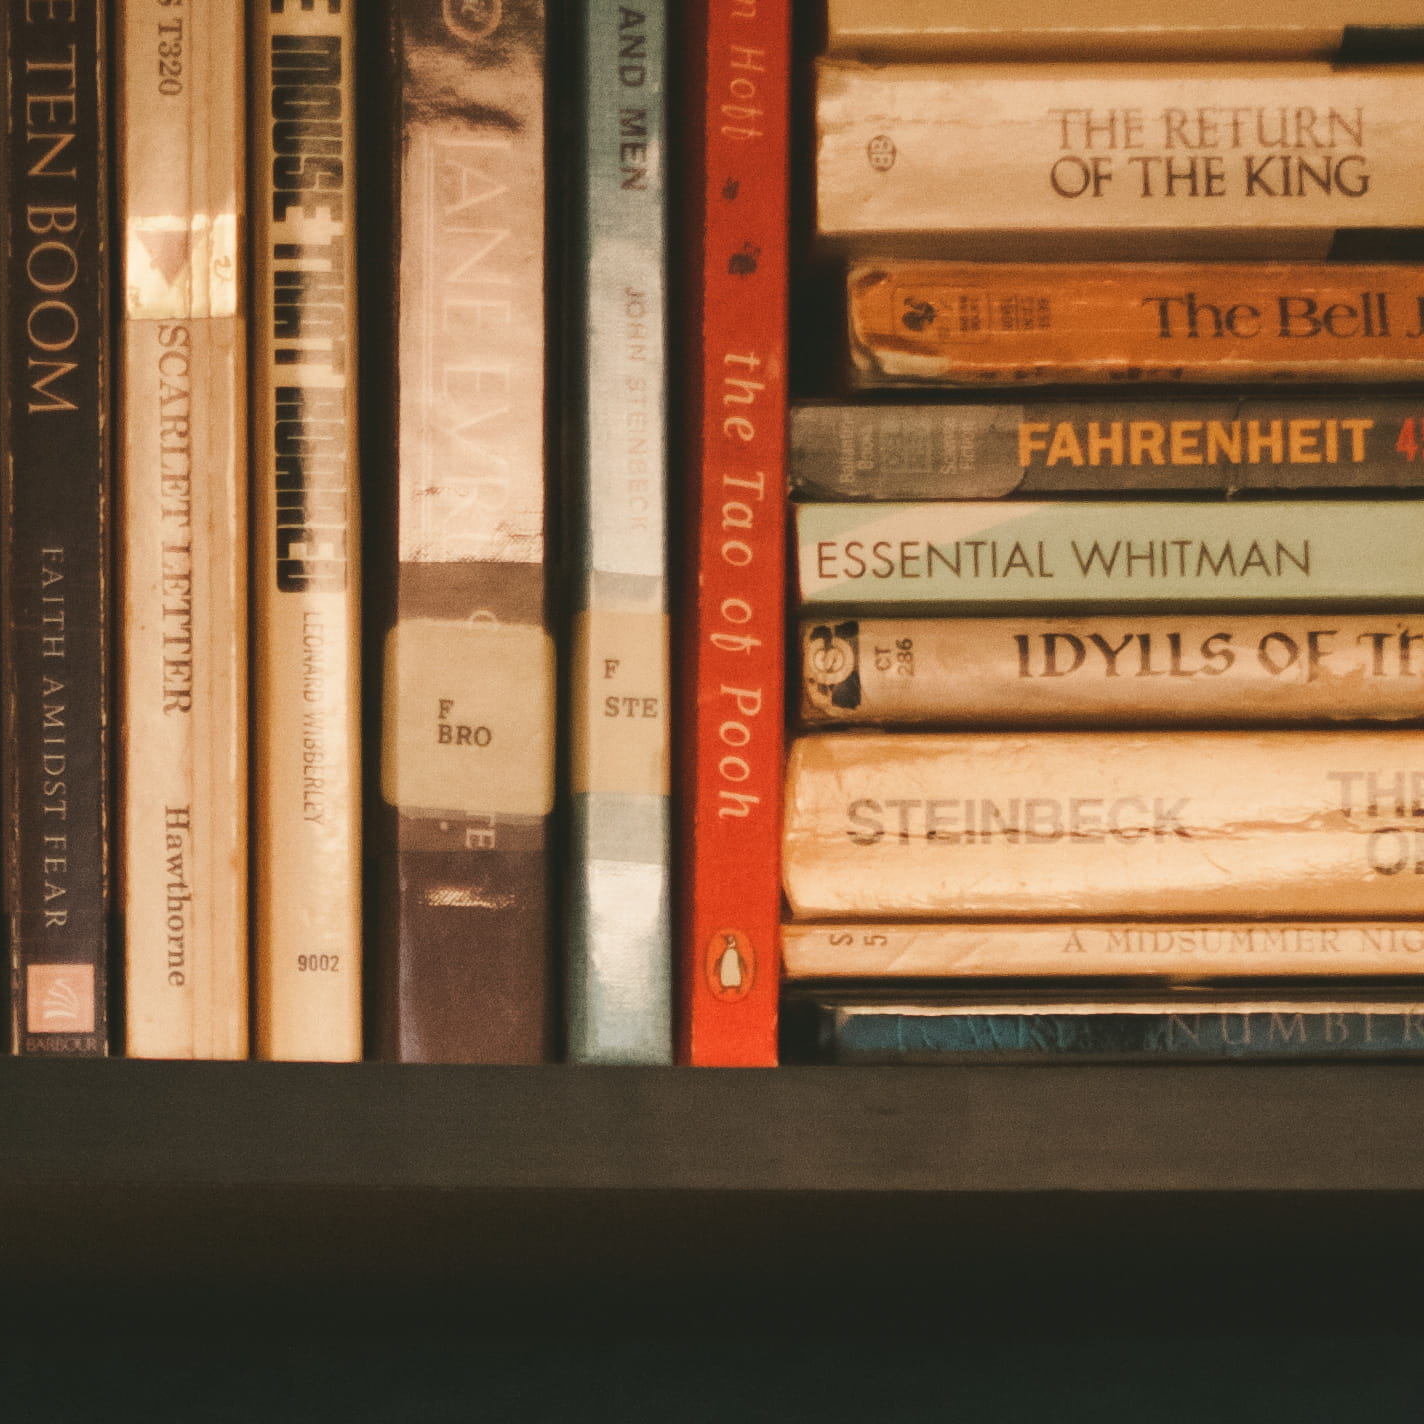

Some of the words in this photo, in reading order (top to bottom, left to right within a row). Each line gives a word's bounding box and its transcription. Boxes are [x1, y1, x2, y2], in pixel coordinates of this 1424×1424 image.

[158, 19, 183, 97] T320
[619, 6, 646, 87] AND
[26, 44, 77, 182] TEN
[1047, 107, 1145, 150] THE
[1162, 106, 1366, 150] RETURN
[620, 107, 648, 192] MEN
[1050, 154, 1114, 198] OF
[1127, 155, 1226, 198] THE
[1244, 154, 1372, 198] KING
[26, 202, 79, 416] BOOM
[1142, 296, 1262, 339] The
[1275, 292, 1388, 339] Bell
[720, 352, 765, 442] the
[158, 323, 192, 528] SCARLET
[1016, 419, 1375, 467] FAHRENHEIT
[720, 470, 765, 568] Tao
[817, 539, 1055, 580] ESSENTIAL
[1071, 538, 1311, 579] WHITMAN
[39, 547, 65, 658] FAITH
[159, 541, 194, 717] LETTER
[708, 600, 764, 654] of
[603, 659, 620, 680] F
[896, 637, 914, 677] 286
[1014, 630, 1235, 679] IDYLLS
[1256, 629, 1340, 683] OF
[437, 700, 454, 721] F
[603, 698, 658, 719] STE
[41, 676, 67, 820] AMIDST
[437, 724, 493, 748] BRO
[717, 685, 762, 822] Pooh
[845, 797, 1194, 847] STEINBECK
[42, 834, 68, 929] FEAR
[162, 805, 192, 988] Hawthorne
[296, 954, 341, 973] 9002
[1061, 929, 1084, 954] A
[1105, 929, 1341, 954] MIDSUMMER
